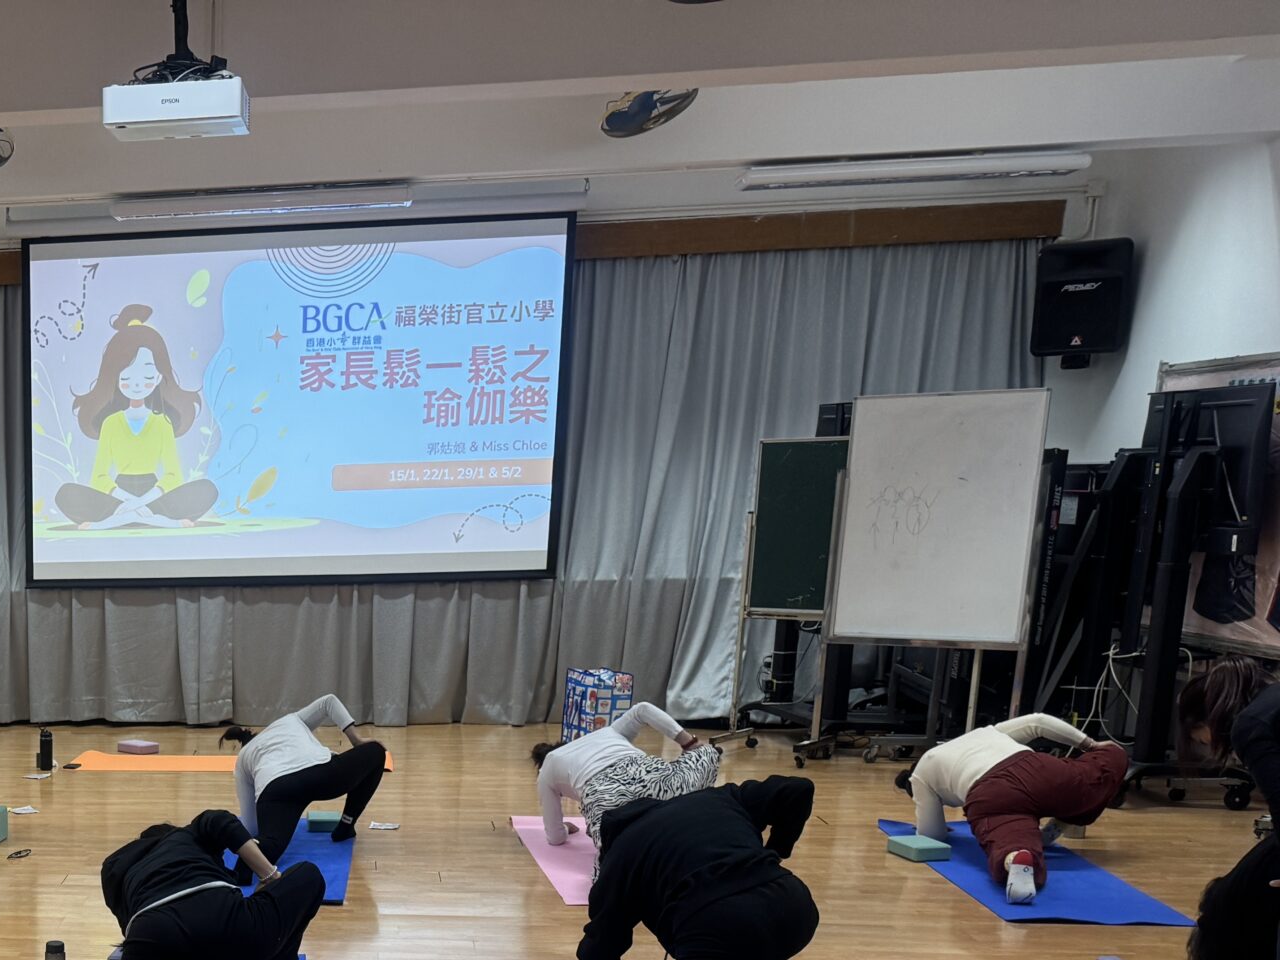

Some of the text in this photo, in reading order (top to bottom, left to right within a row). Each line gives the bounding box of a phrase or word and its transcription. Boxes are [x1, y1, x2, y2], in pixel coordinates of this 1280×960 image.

[299, 302, 387, 333] BGCA
[394, 299, 555, 328] 福榮街官立小學
[299, 344, 551, 393] 家長鬆一鬆之
[422, 384, 549, 428] 瑜伽樂
[470, 441, 479, 452] &
[482, 440, 510, 453] Miss
[512, 439, 548, 452] Chloe
[457, 467, 485, 481] 29/1
[489, 467, 498, 479] &
[501, 466, 522, 479] 5/2
